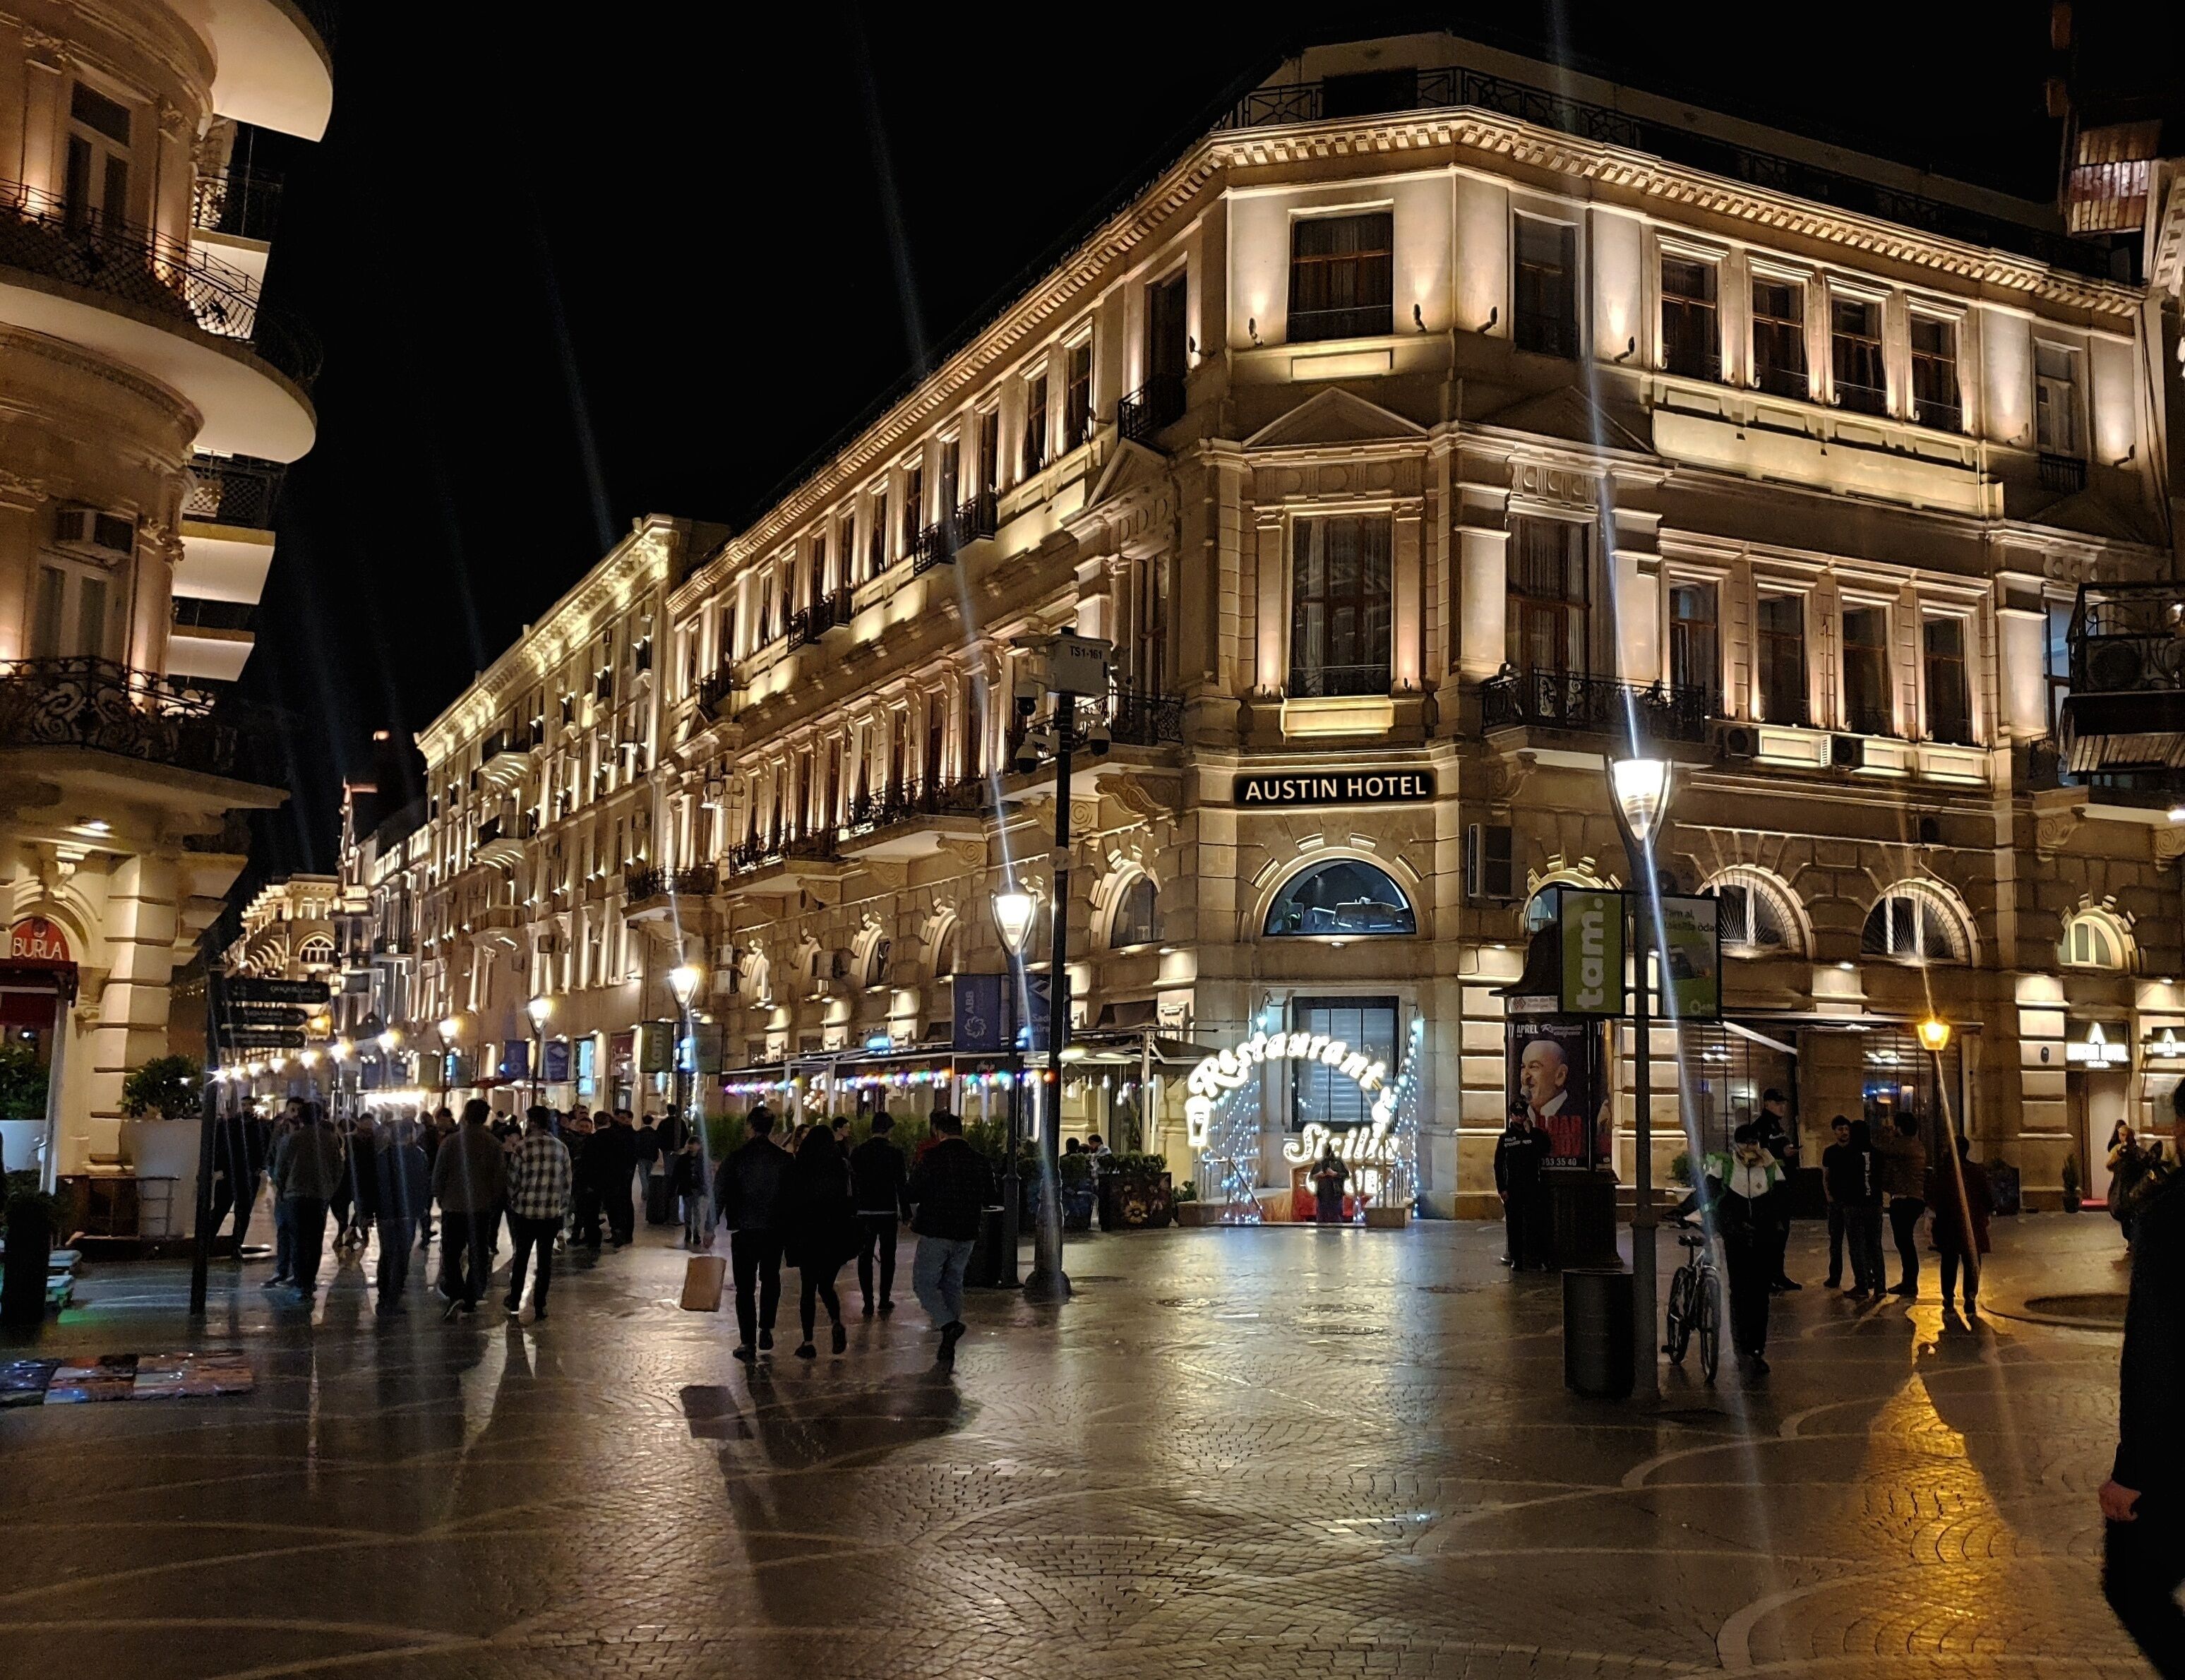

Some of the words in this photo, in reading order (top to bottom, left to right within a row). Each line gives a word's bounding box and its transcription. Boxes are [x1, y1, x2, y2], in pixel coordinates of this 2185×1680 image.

[1245, 778, 1338, 800] AUSTIN
[1346, 776, 1427, 798] HOTEL
[12, 937, 63, 960] BURLA
[1516, 1024, 1539, 1034] APREL
[1187, 1031, 1387, 1098] Restaurant
